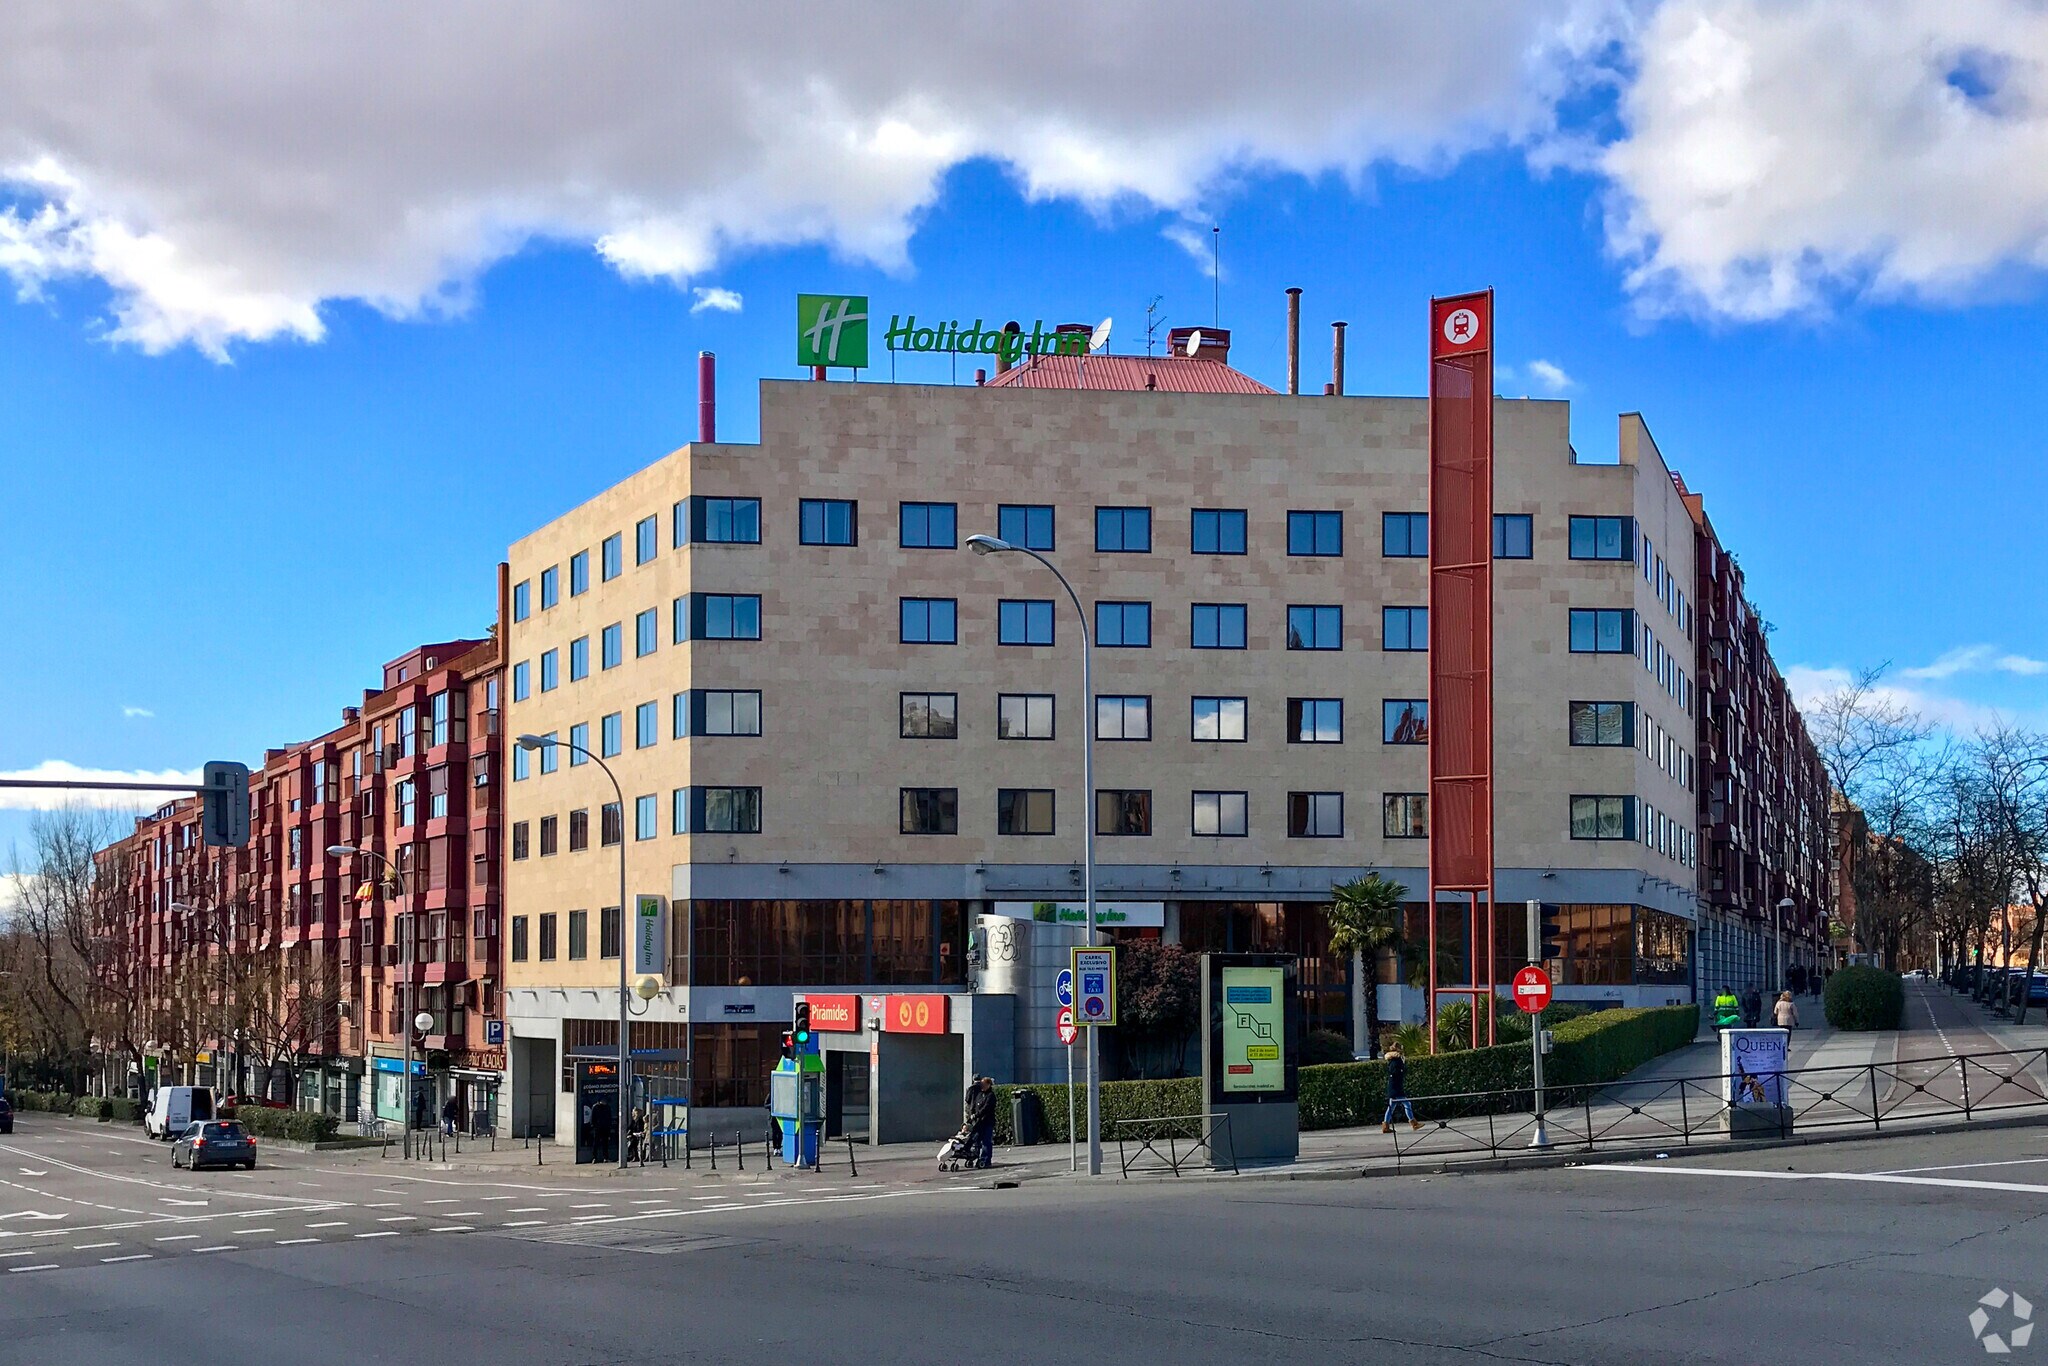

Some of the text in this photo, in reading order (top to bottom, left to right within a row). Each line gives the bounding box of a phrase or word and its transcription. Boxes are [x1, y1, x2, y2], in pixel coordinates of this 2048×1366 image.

[884, 315, 1085, 363] Holiday Inn
[643, 919, 654, 966] Holiday Inn
[811, 1004, 848, 1021] Pirámides
[491, 1023, 501, 1036] P
[1241, 1017, 1247, 1026] F
[1262, 1027, 1267, 1035] L
[482, 1054, 504, 1070] ACACIAS
